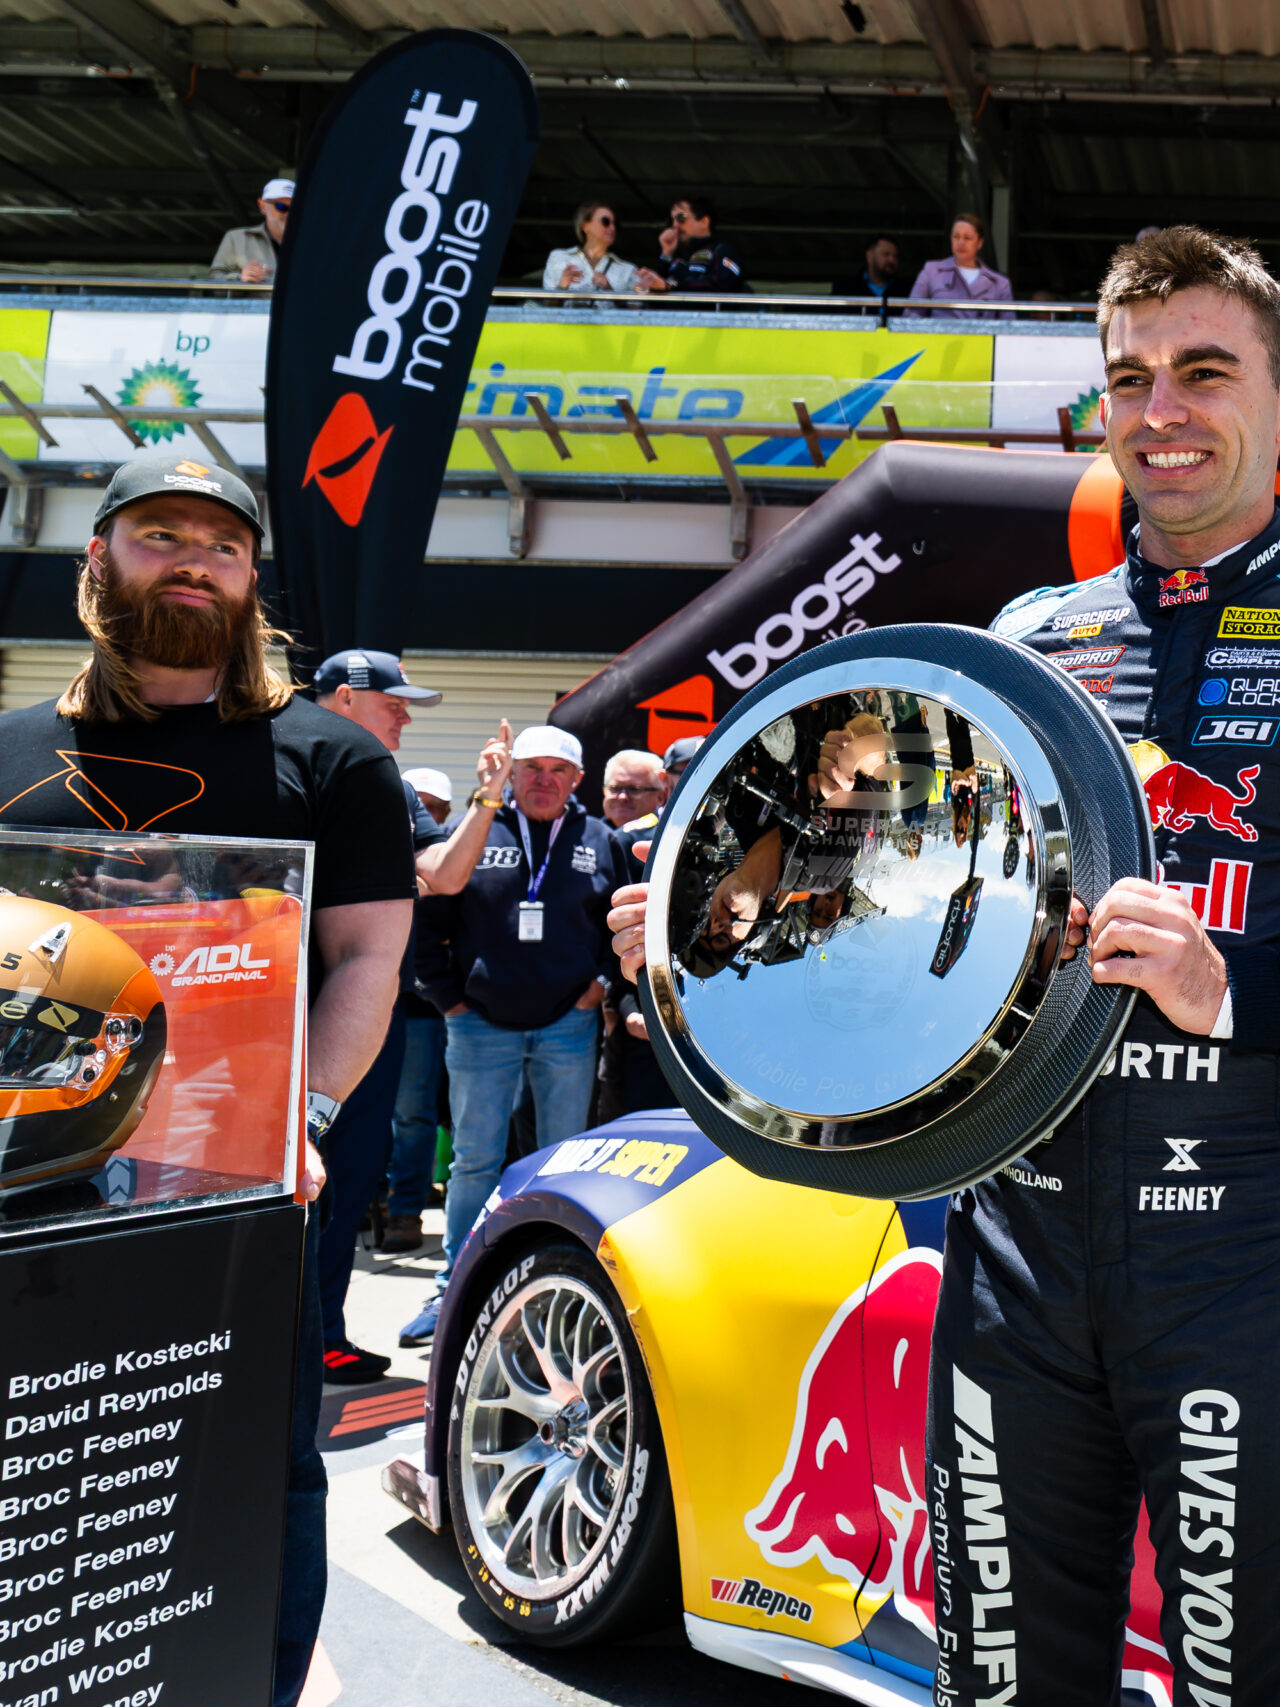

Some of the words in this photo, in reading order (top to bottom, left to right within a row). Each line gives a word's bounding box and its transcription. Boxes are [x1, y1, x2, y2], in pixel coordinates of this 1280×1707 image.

[332, 92, 478, 380] boost
[401, 199, 489, 392] mobile
[175, 329, 211, 356] bp
[464, 361, 745, 432] imate
[706, 531, 902, 690] boost
[1052, 607, 1131, 632] SUPERCHEAP
[1159, 590, 1184, 607] Red
[1184, 585, 1210, 604] Bull
[1071, 626, 1099, 637] AUTO
[1199, 721, 1273, 742] JGI
[171, 973, 222, 988] GRAND
[223, 970, 268, 984] FINAL
[174, 942, 270, 976] ADL
[1009, 1167, 1064, 1192] HOLLAND
[1138, 1185, 1227, 1212] FEENEY
[456, 1253, 537, 1397] DUNLOP
[8, 1361, 106, 1400] Brodie
[114, 1330, 232, 1376] Kostecki
[4, 1399, 90, 1440] David
[98, 1370, 223, 1418] Reynolds
[1, 1446, 74, 1481] Broc
[82, 1418, 183, 1460] Feeney
[1178, 1389, 1241, 1559] GIVES
[0, 1486, 72, 1522] Broc
[79, 1455, 181, 1499] Feeney
[609, 1443, 650, 1562] SPORT
[0, 1526, 68, 1562] Broc
[76, 1493, 178, 1538] Feeney
[933, 1463, 956, 1617] Premium
[0, 1566, 65, 1602] Broc
[73, 1530, 176, 1578] Feeney
[70, 1568, 173, 1618] Feeney
[553, 1559, 615, 1625] MAXX
[954, 1423, 1019, 1707] AMPLIFY
[94, 1585, 215, 1648] Kostecki
[738, 1577, 814, 1624] Repco
[1179, 1567, 1236, 1686] YOU
[67, 1644, 152, 1695] Wood
[936, 1625, 960, 1707] Fuels
